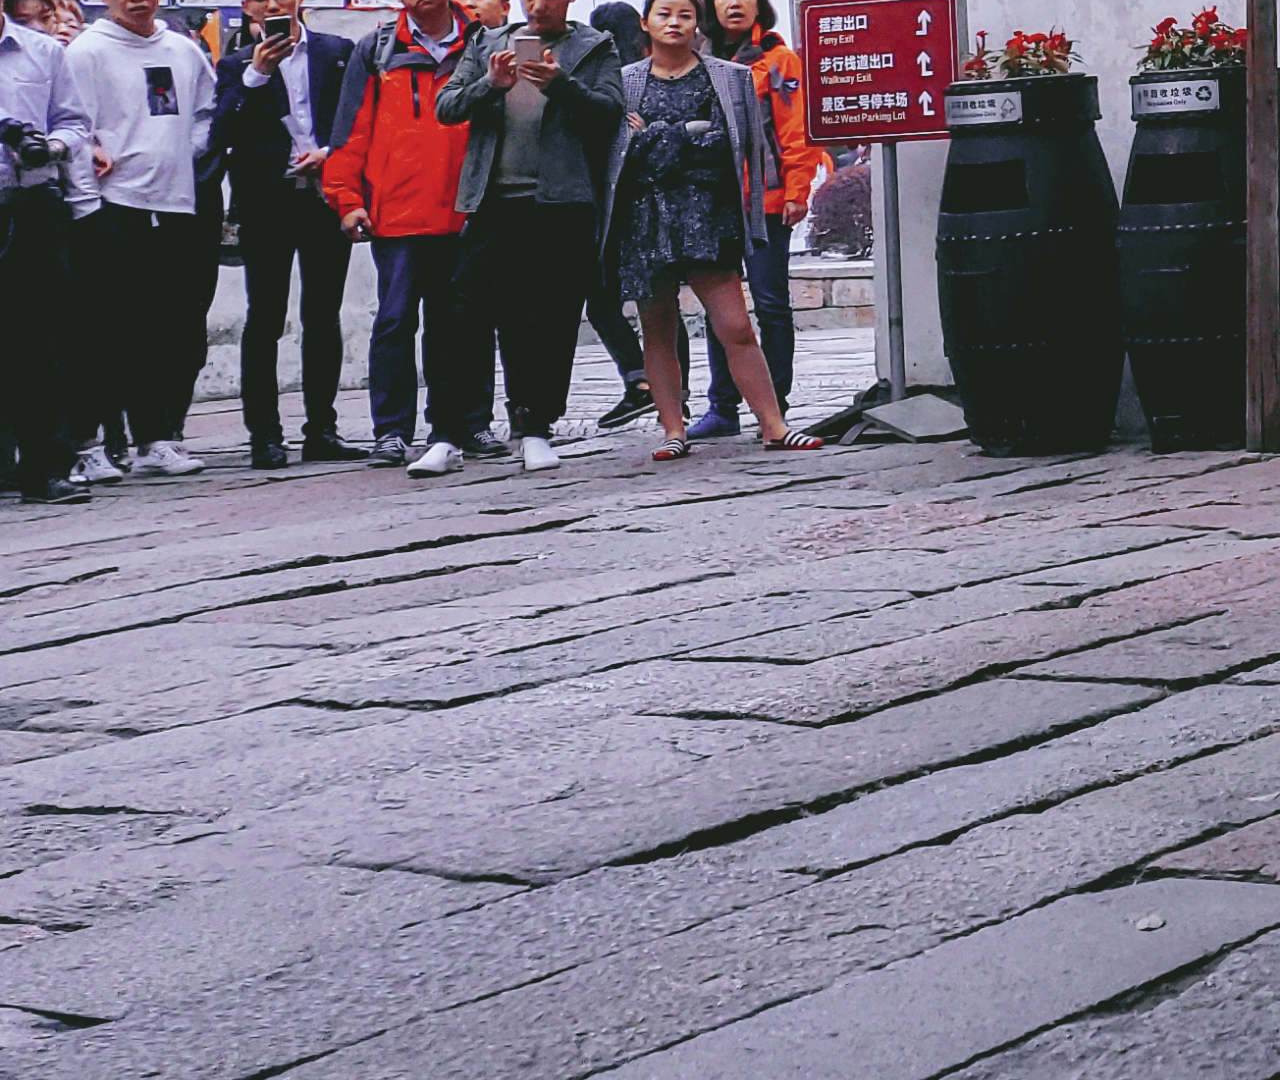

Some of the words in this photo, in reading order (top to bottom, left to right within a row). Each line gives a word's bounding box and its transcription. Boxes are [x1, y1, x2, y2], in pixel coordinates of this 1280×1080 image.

[819, 36, 838, 46] Ferry
[838, 34, 854, 44] Exit
[820, 53, 894, 73] 步行栈道出口
[820, 75, 855, 85] Walkway
[856, 72, 872, 83] Exit
[821, 92, 908, 112] 景区二号停车场
[841, 113, 861, 123] West
[861, 112, 892, 123] Parking
[892, 110, 906, 120] Lot
